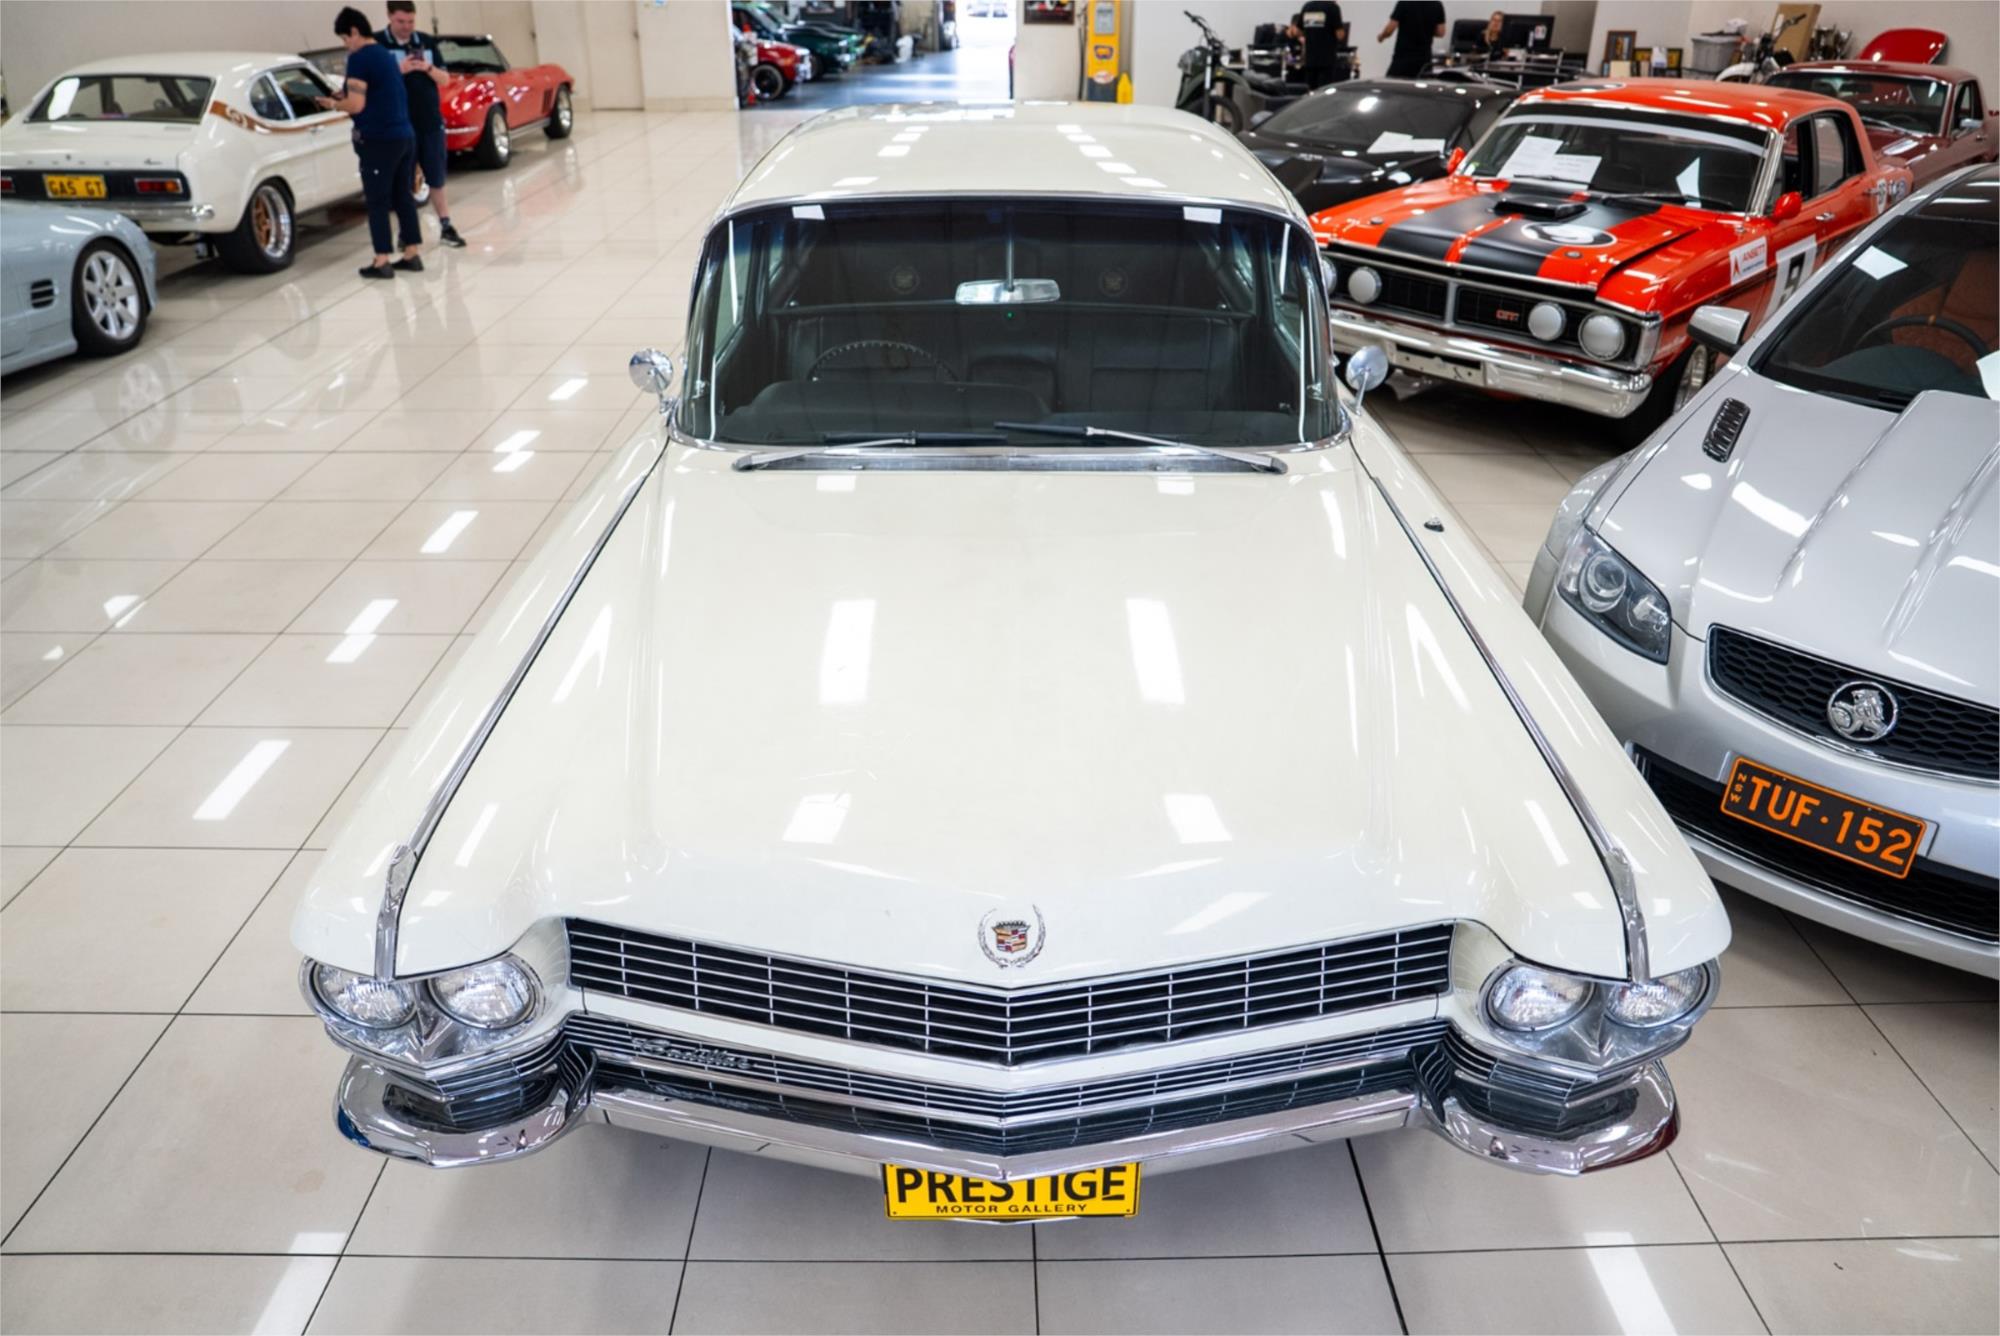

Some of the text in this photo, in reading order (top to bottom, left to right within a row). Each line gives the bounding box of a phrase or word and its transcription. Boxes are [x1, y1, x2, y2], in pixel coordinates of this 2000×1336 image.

[49, 181, 102, 196] GAS GT
[895, 1164, 1127, 1203] PRESTIGE
[936, 1203, 1088, 1214] MOTOR GALLERY
